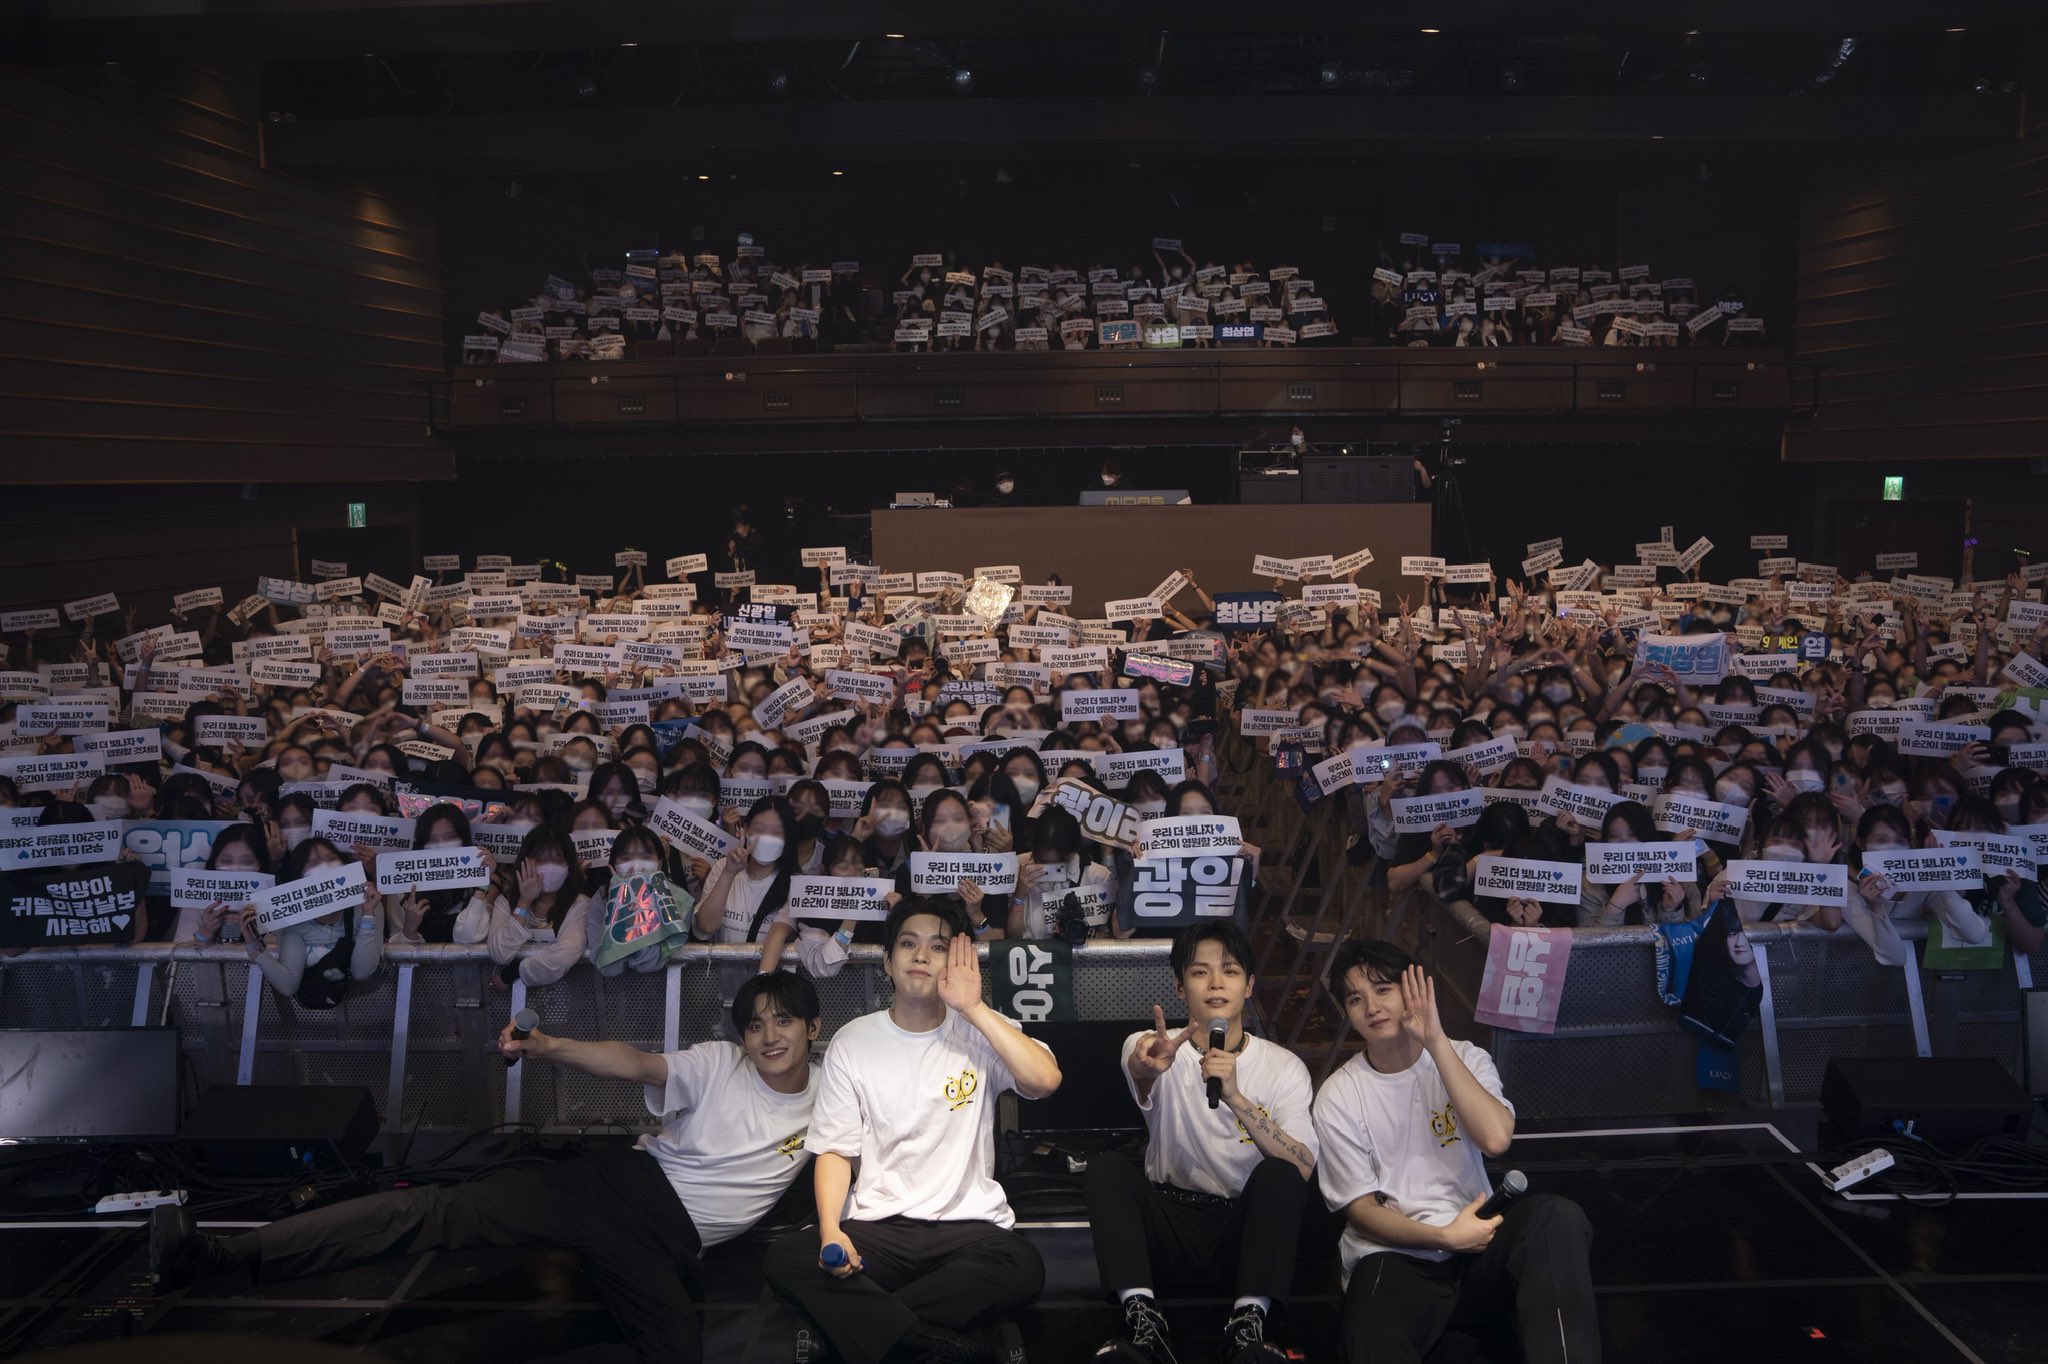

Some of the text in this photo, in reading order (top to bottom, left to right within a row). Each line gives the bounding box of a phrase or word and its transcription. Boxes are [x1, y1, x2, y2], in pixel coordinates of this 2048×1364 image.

[738, 604, 776, 620] 신광일
[1406, 799, 1461, 813] 우리 더 빛나자
[1665, 802, 1721, 819] 우리 더 빛나자
[1406, 815, 1431, 824] 순간이
[1433, 811, 1458, 822] 영원할
[1460, 806, 1482, 818] 것처럼
[328, 820, 388, 835] 우리 더 빛나자
[1152, 824, 1214, 838] 우리 더 빛나자
[1661, 813, 1685, 824] 순간이
[1687, 817, 1714, 830] 영원할
[1714, 822, 1740, 836] 것처럼
[72, 832, 105, 843] 순간이
[354, 836, 381, 846] 영원할
[383, 838, 410, 848] 것처럼
[1140, 842, 1149, 850] 이
[1151, 840, 1180, 850] 순간이
[1182, 838, 1210, 848] 영원할
[31, 844, 104, 859] 우리 더 빛나자
[1988, 842, 2020, 856] 빛나자
[1604, 851, 1667, 862] 우리 더 빛나자
[1883, 857, 1956, 870] 우리 더 빛나자
[1982, 854, 2013, 866] 영원할
[395, 857, 459, 871] 우리 더 빛나자
[928, 862, 992, 874] 우리 더 빛나자
[1590, 864, 1599, 874] 이
[1602, 863, 1630, 874] 순간이
[1664, 862, 1692, 873] 것처럼
[381, 867, 486, 885] 이 순간이 영원할 것처럼
[914, 875, 923, 884] 이
[925, 874, 956, 886] 순간이
[988, 874, 1014, 886] 것처럼
[1491, 865, 1551, 881] 우리 더 빛나자
[1746, 870, 1814, 883] 우리 더 빛나자
[1918, 871, 1952, 882] 영원할
[1953, 868, 1982, 880] 것처럼
[46, 876, 112, 900] 원상아
[805, 885, 865, 897] 우리 더 빛나자
[1132, 857, 1244, 918] 광일
[1478, 876, 1577, 895] 이 순간이 영원할 것처럼
[1743, 882, 1774, 893] 순간이
[1777, 883, 1809, 895] 영원할
[1811, 885, 1843, 897] 것처럼
[271, 880, 335, 908] 우리 더 빛나자
[260, 883, 366, 923] 이 순간이 영원할 것처럼
[791, 898, 799, 907] 이
[801, 898, 829, 908] 순간이
[832, 899, 860, 910] 영원할
[46, 916, 112, 936] 사랑해
